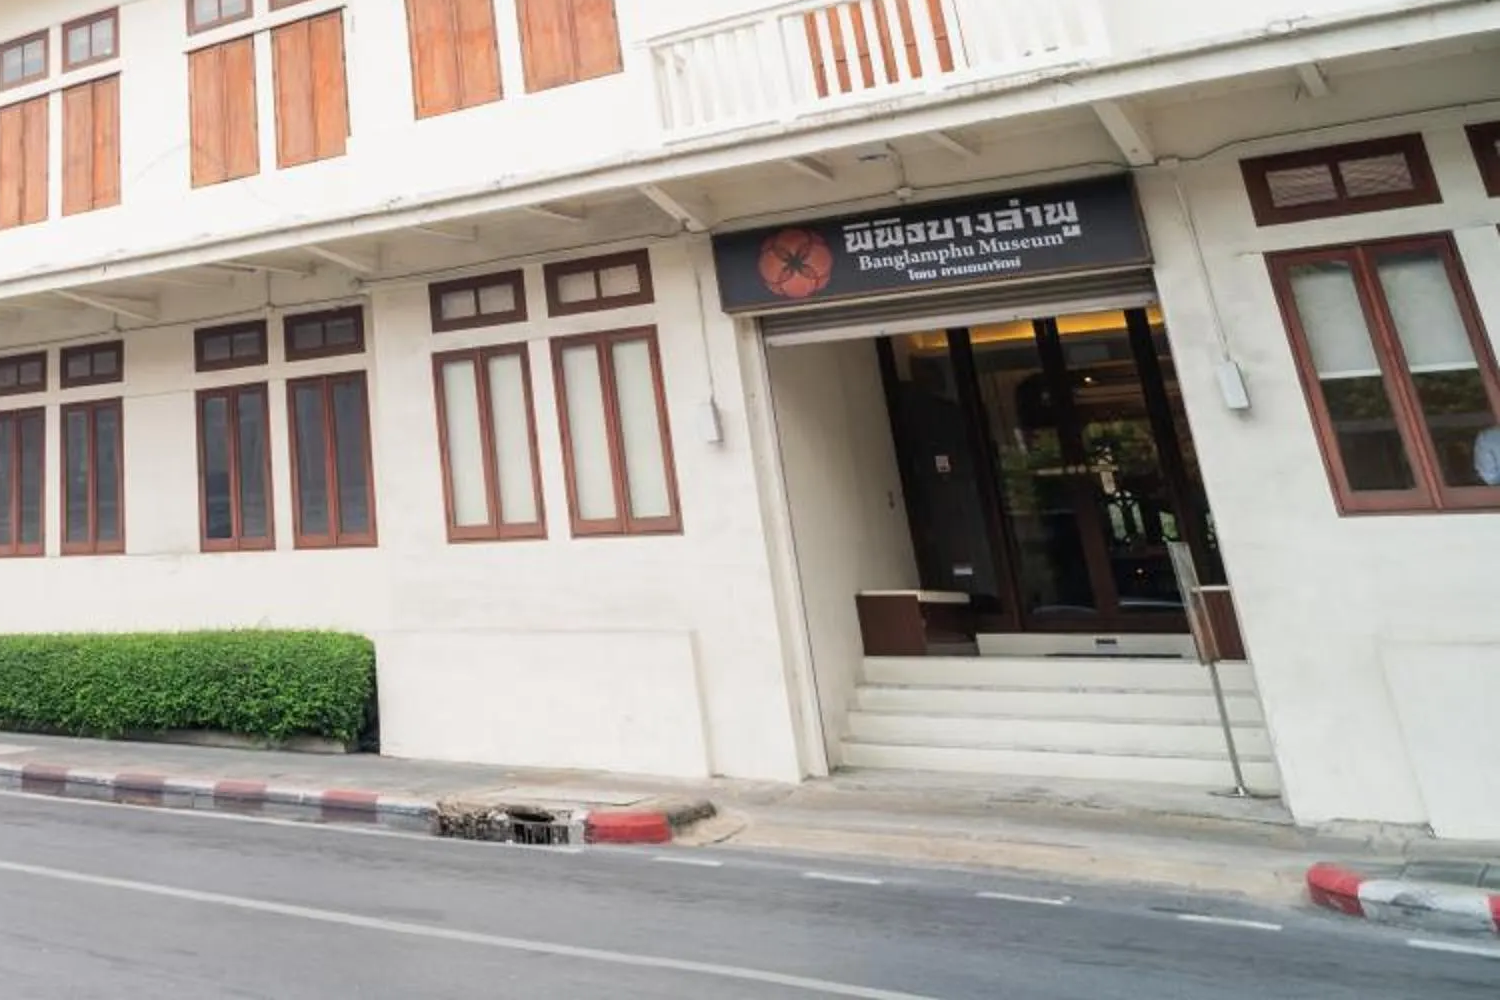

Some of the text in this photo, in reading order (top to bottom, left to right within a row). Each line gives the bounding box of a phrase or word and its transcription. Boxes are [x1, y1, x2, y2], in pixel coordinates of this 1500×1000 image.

[842, 199, 1082, 253] พิพิธบางลำพู
[858, 232, 1064, 271] Banglamphu Museum
